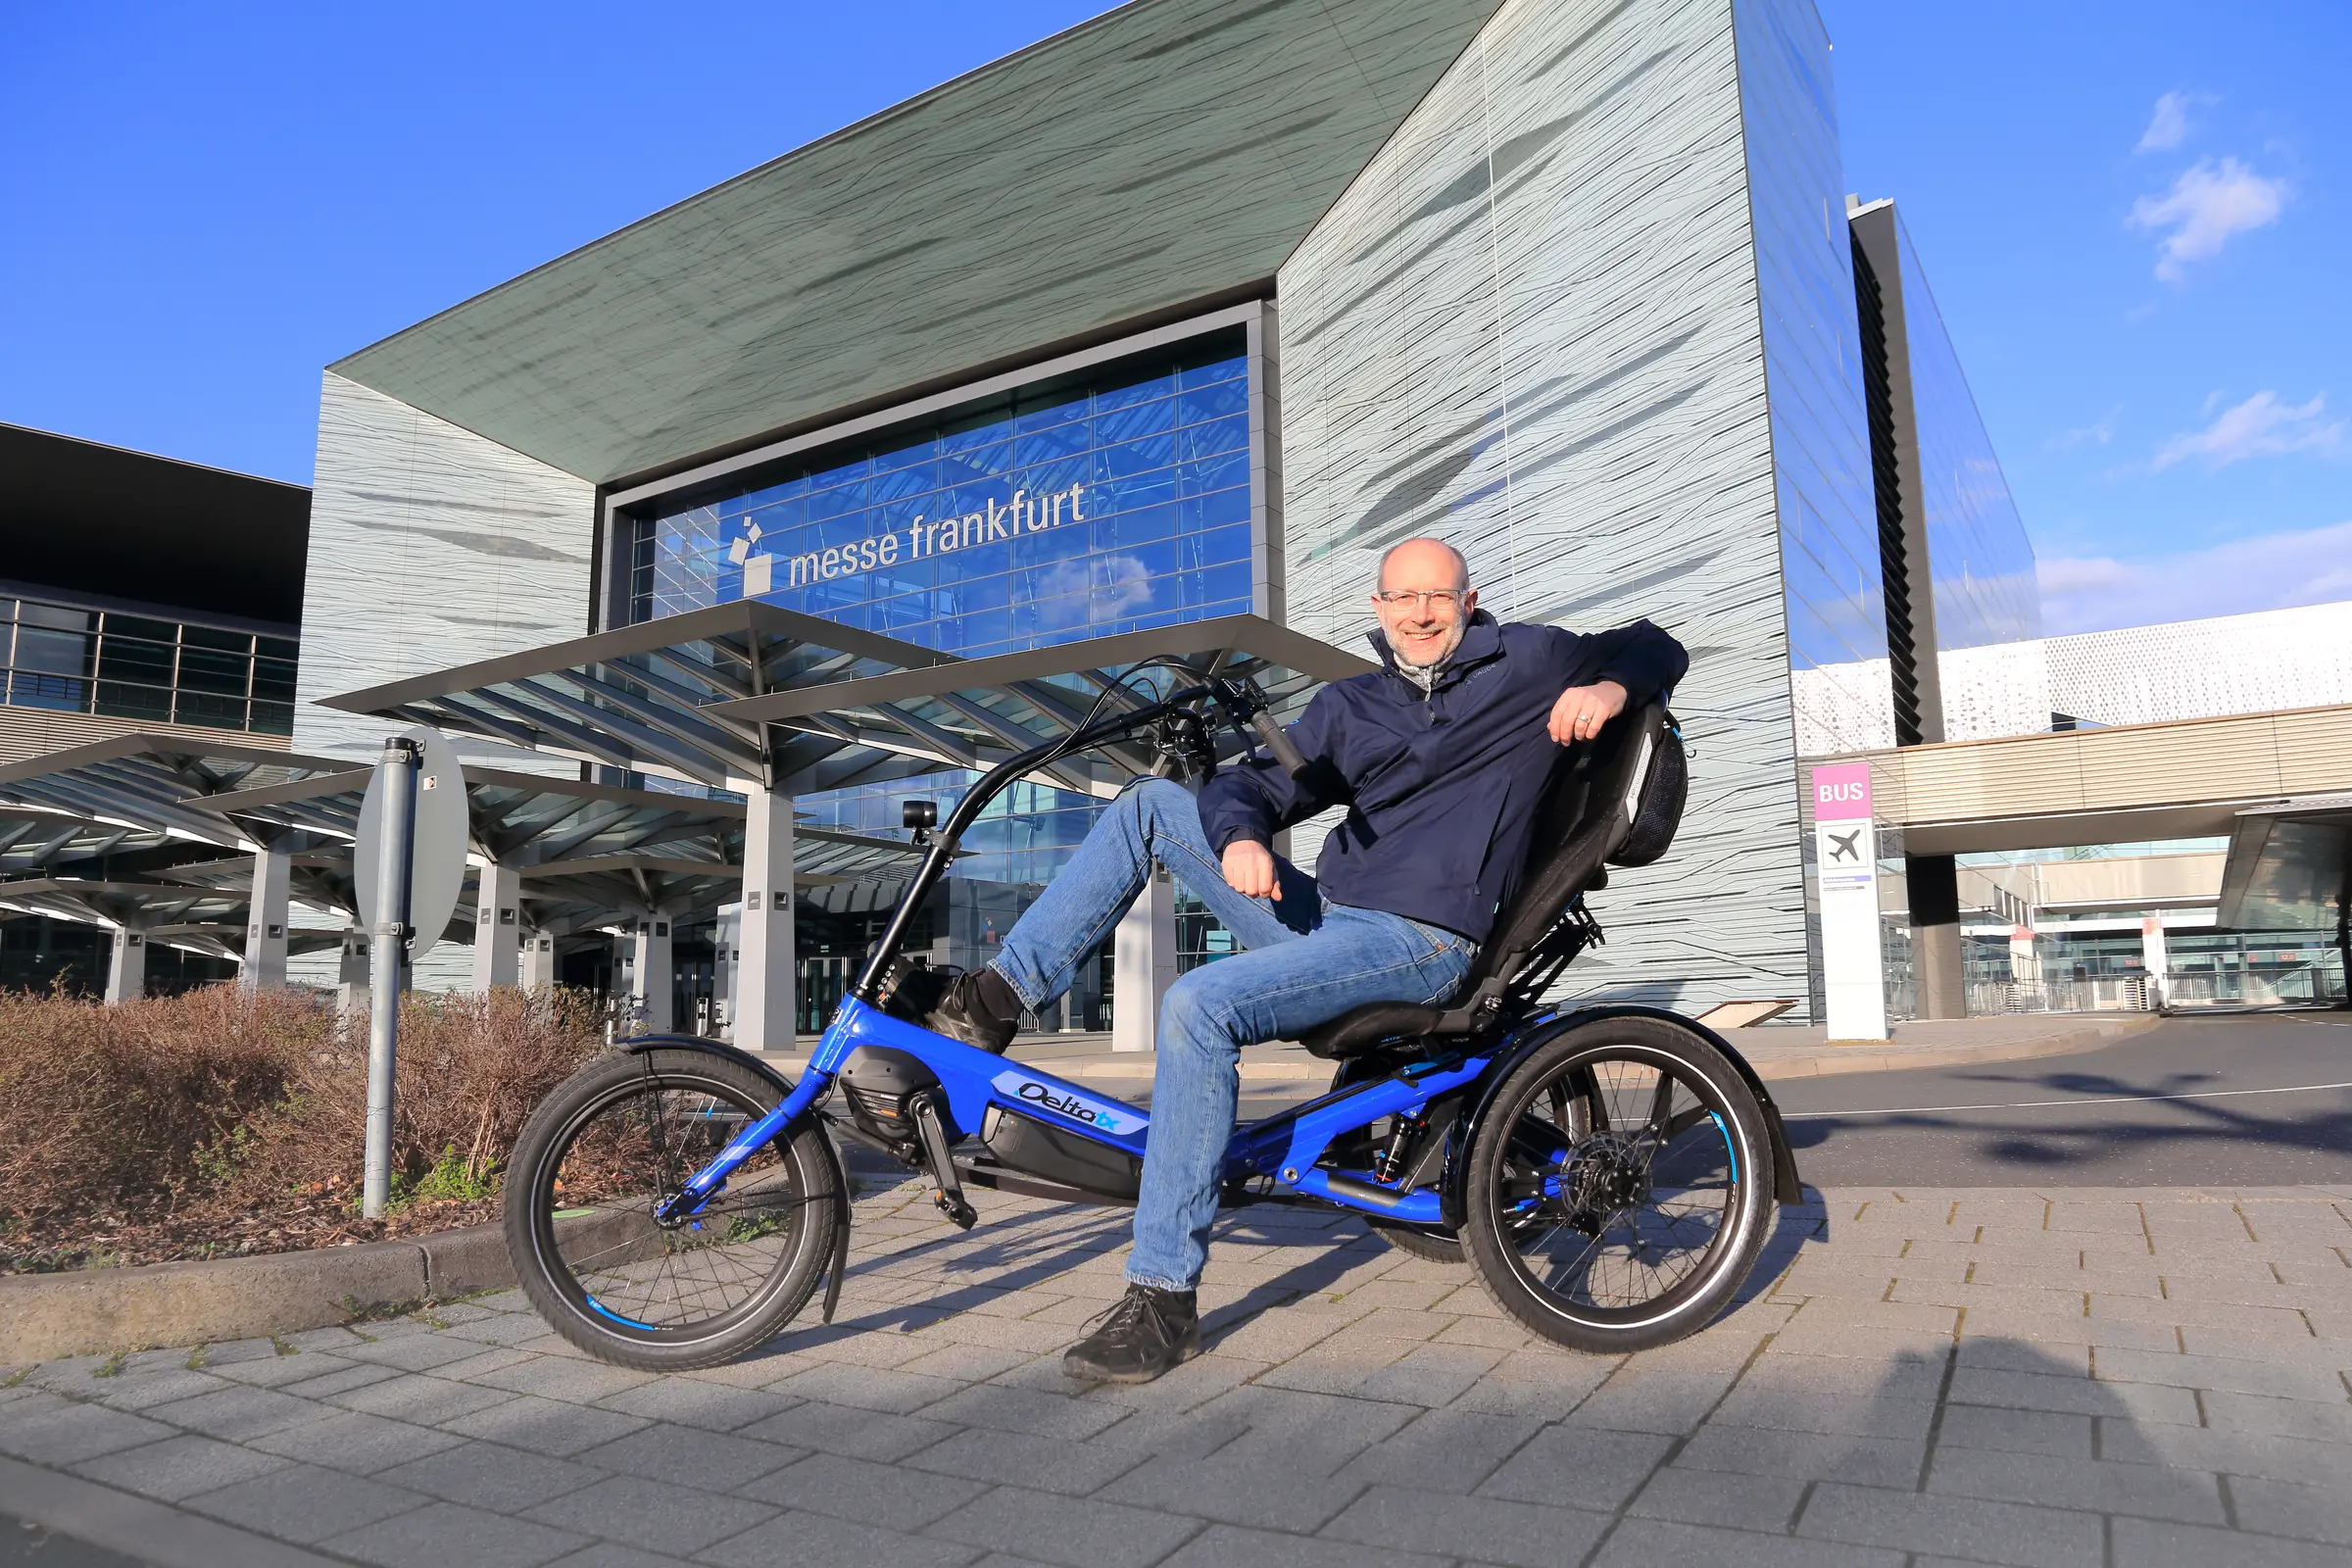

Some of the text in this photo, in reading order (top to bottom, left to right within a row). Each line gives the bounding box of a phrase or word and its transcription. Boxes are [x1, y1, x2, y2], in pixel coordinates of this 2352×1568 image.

[790, 481, 1085, 587] messe frankfurt
[1472, 663, 1496, 678] VAUDE
[1819, 782, 1864, 803] BUS
